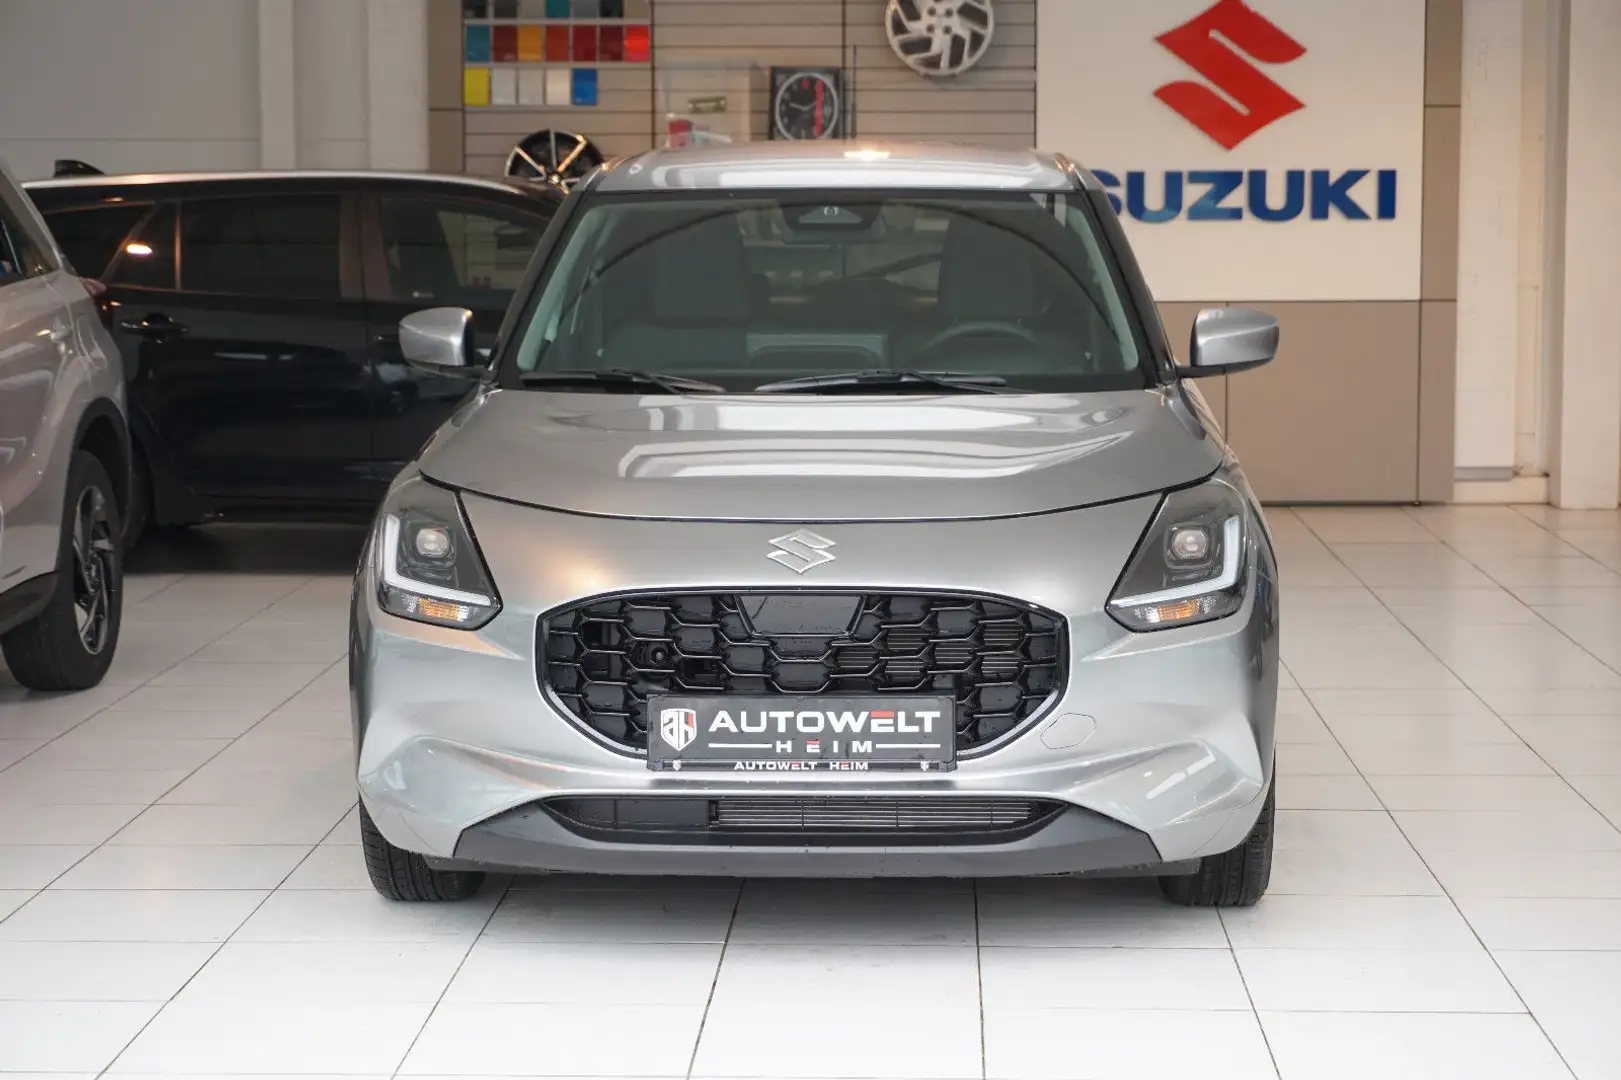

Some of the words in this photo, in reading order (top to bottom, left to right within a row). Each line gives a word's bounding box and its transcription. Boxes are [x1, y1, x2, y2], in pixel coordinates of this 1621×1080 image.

[709, 710, 941, 733] AUTOWELT
[776, 740, 873, 754] HEIM
[734, 760, 818, 772] AUTOWELT
[829, 760, 869, 772] HEIM
